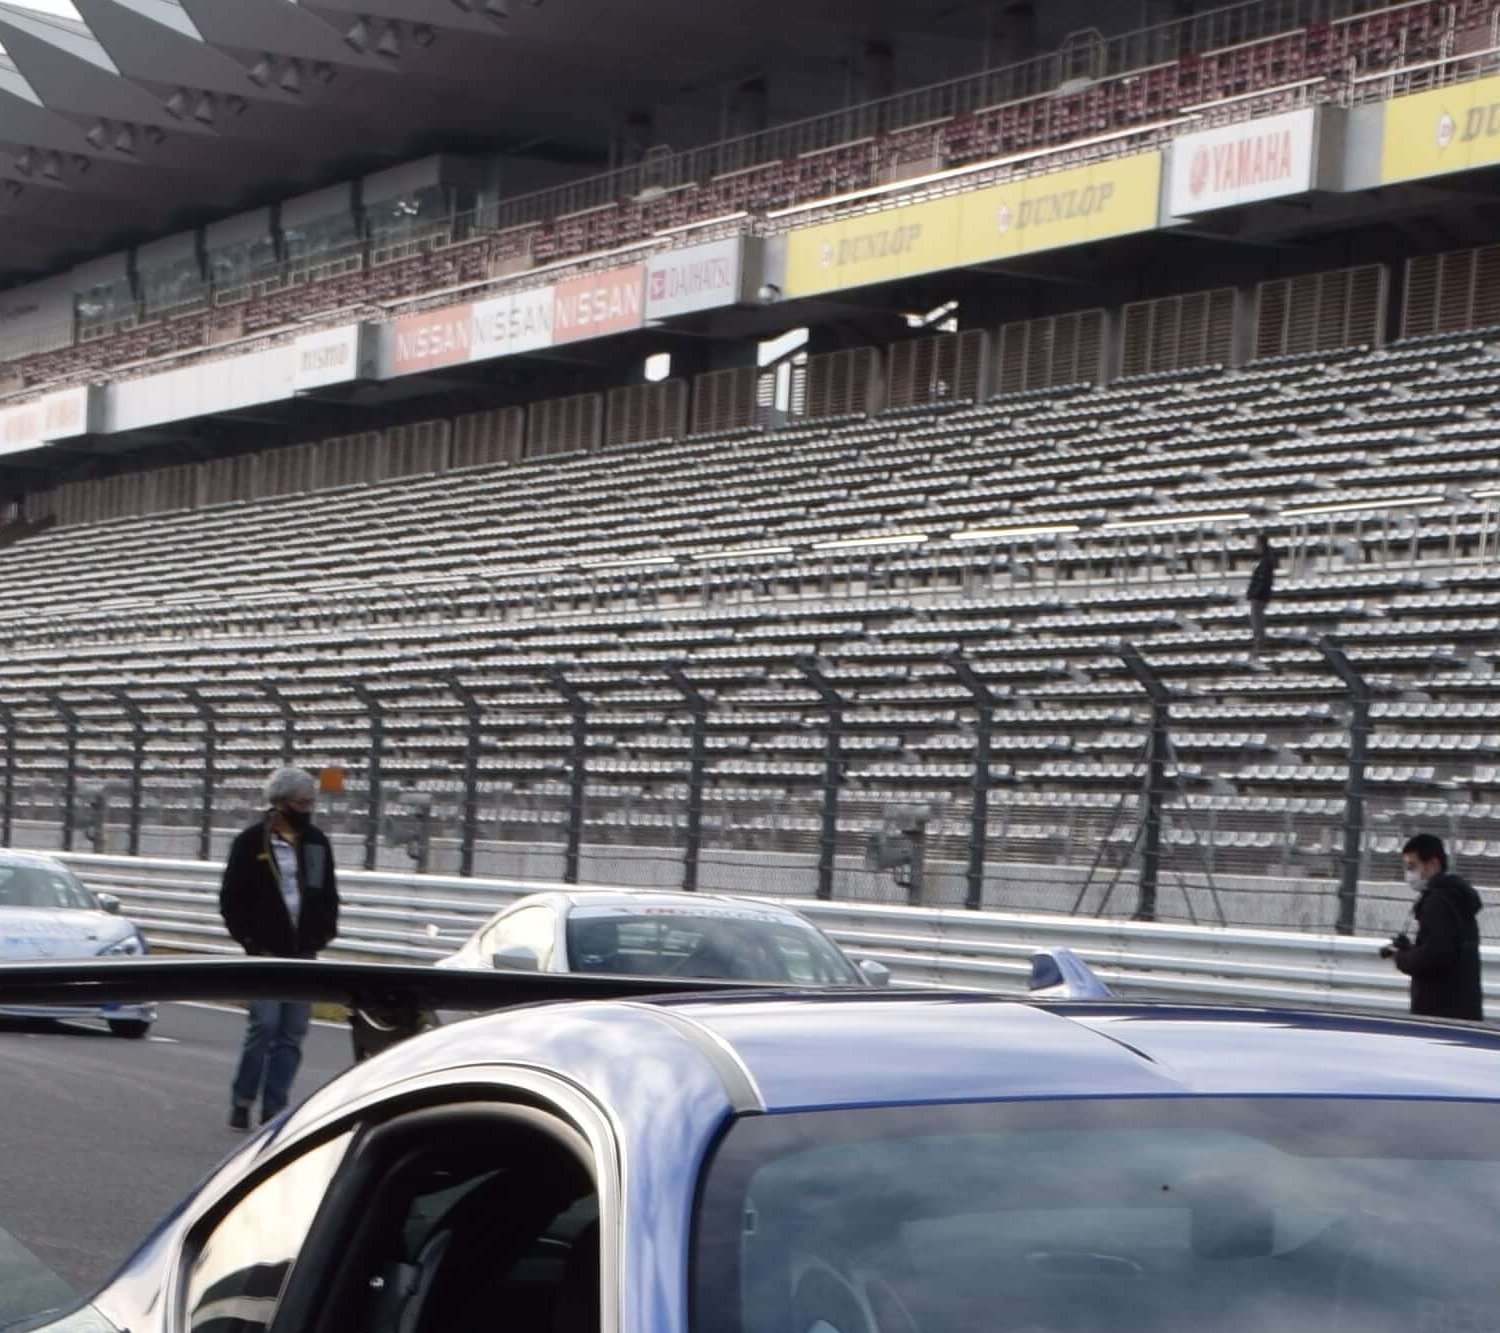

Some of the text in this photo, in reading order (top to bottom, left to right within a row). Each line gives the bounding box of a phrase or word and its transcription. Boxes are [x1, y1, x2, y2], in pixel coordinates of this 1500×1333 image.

[1213, 131, 1293, 192] YAMAHA
[1016, 182, 1116, 231] DUNLOP
[835, 223, 921, 267] DUNLOP
[471, 302, 551, 346] NISSAN
[554, 282, 642, 330] NISSAN
[397, 318, 470, 362] NISSAN
